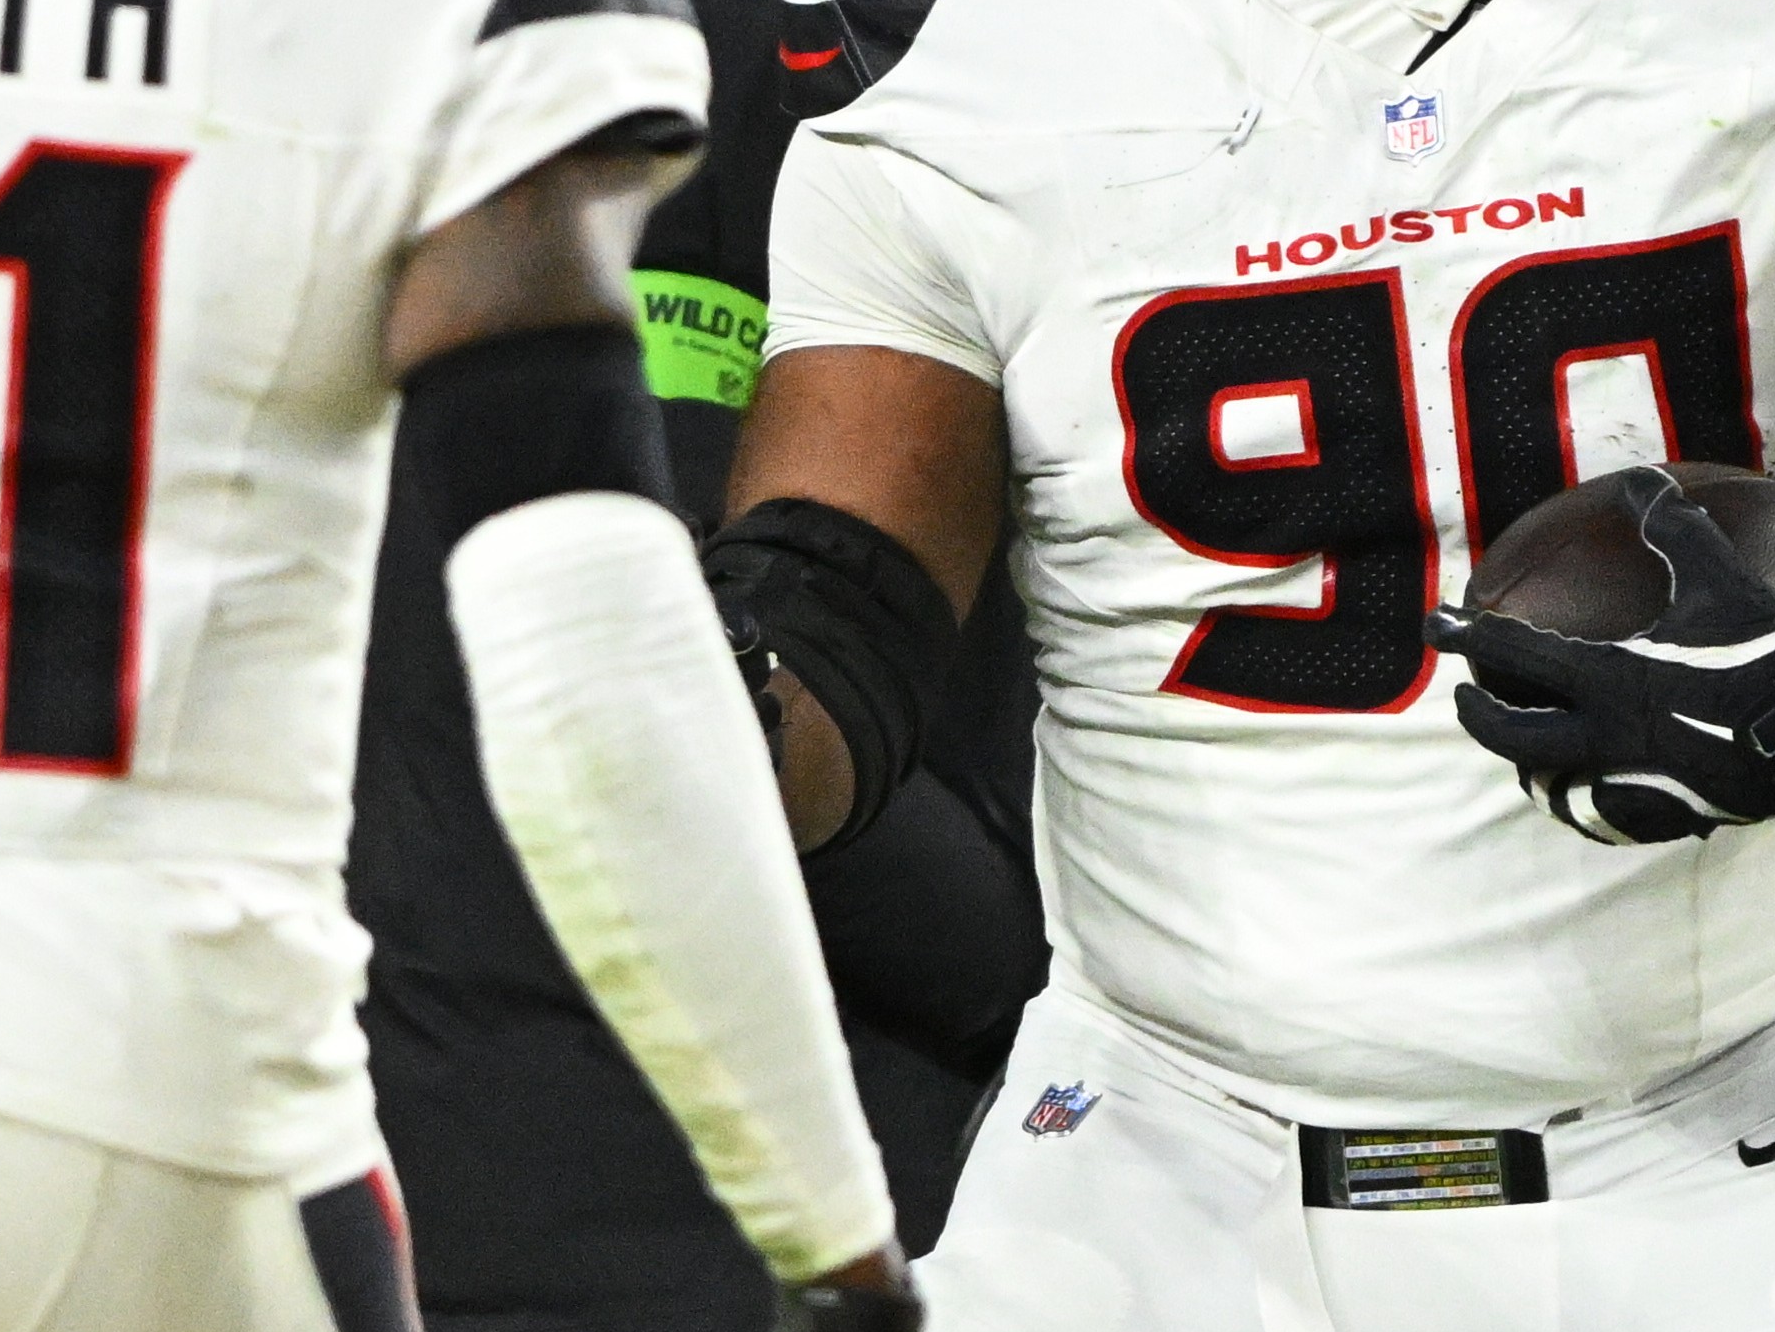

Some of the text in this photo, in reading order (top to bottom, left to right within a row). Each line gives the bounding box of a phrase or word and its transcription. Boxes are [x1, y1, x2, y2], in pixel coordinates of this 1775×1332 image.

[1391, 119, 1435, 150] NFL
[1234, 186, 1585, 277] HOUSTON
[644, 293, 734, 339] WILD
[1111, 218, 1764, 714] 90
[1032, 1104, 1071, 1130] NFL
